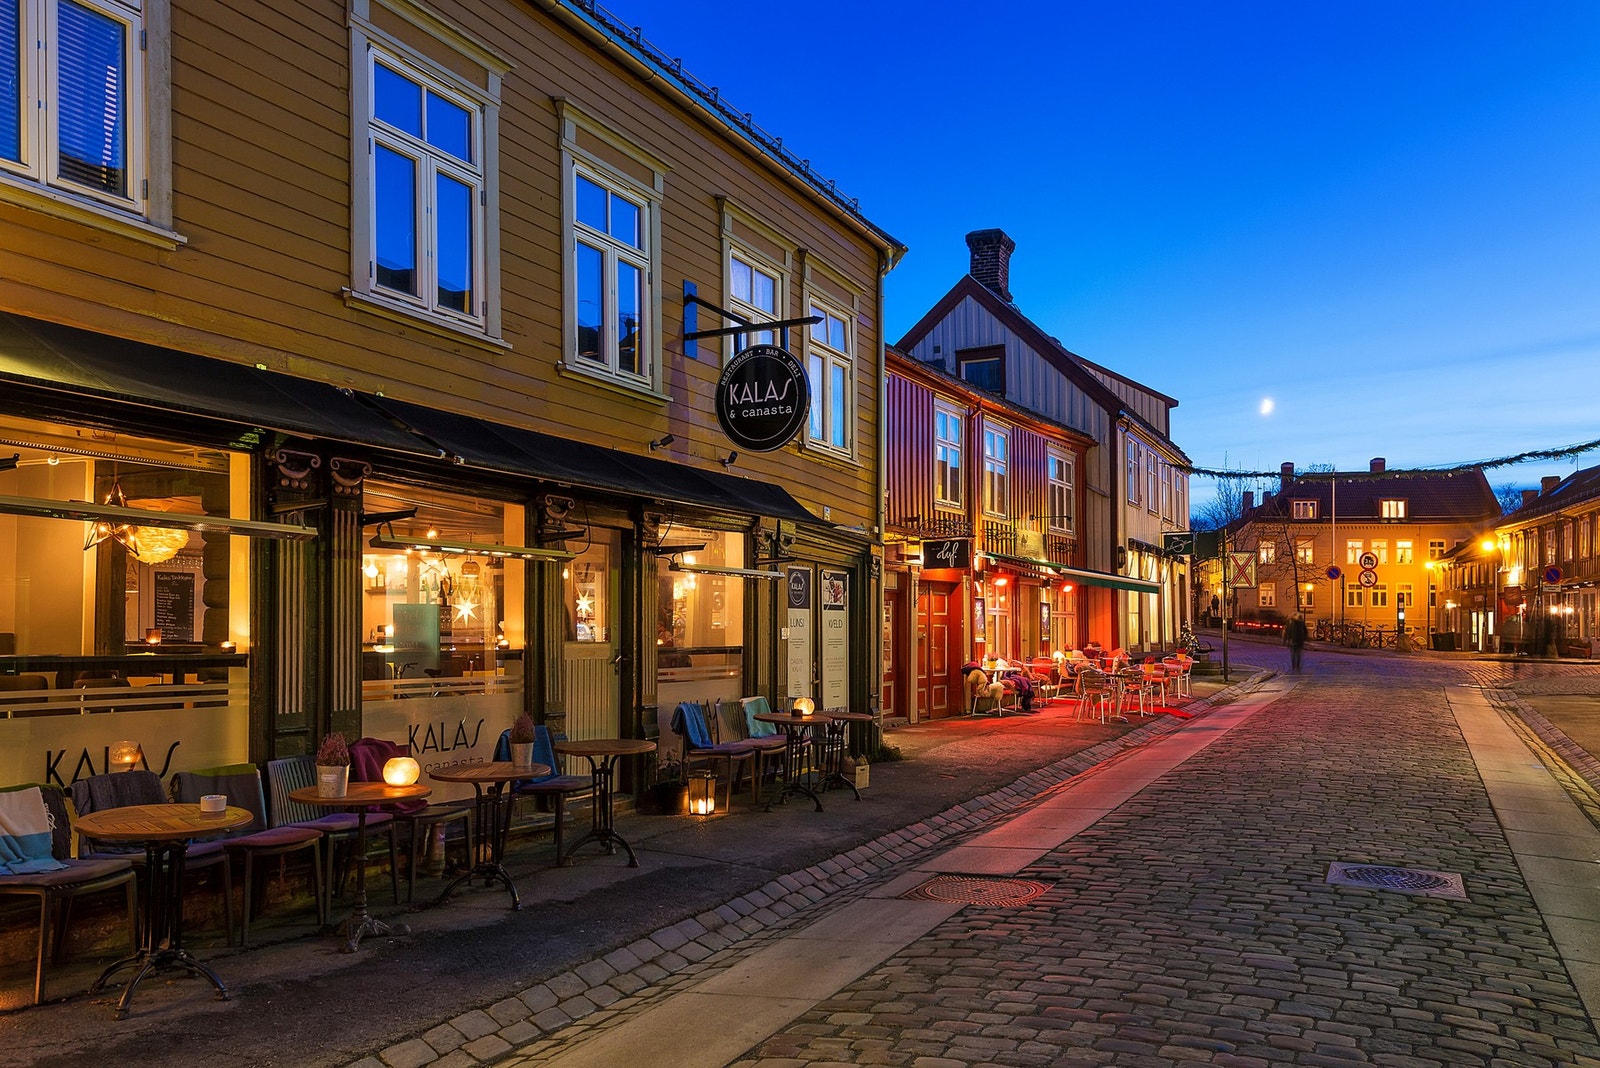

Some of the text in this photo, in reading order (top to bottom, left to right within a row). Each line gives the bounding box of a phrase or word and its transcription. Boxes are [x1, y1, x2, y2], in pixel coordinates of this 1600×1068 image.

[720, 348, 801, 386] RESTAURANT BAR DELI
[729, 378, 792, 405] KALAS
[729, 404, 793, 419] & canasta
[408, 719, 485, 755] KALAS
